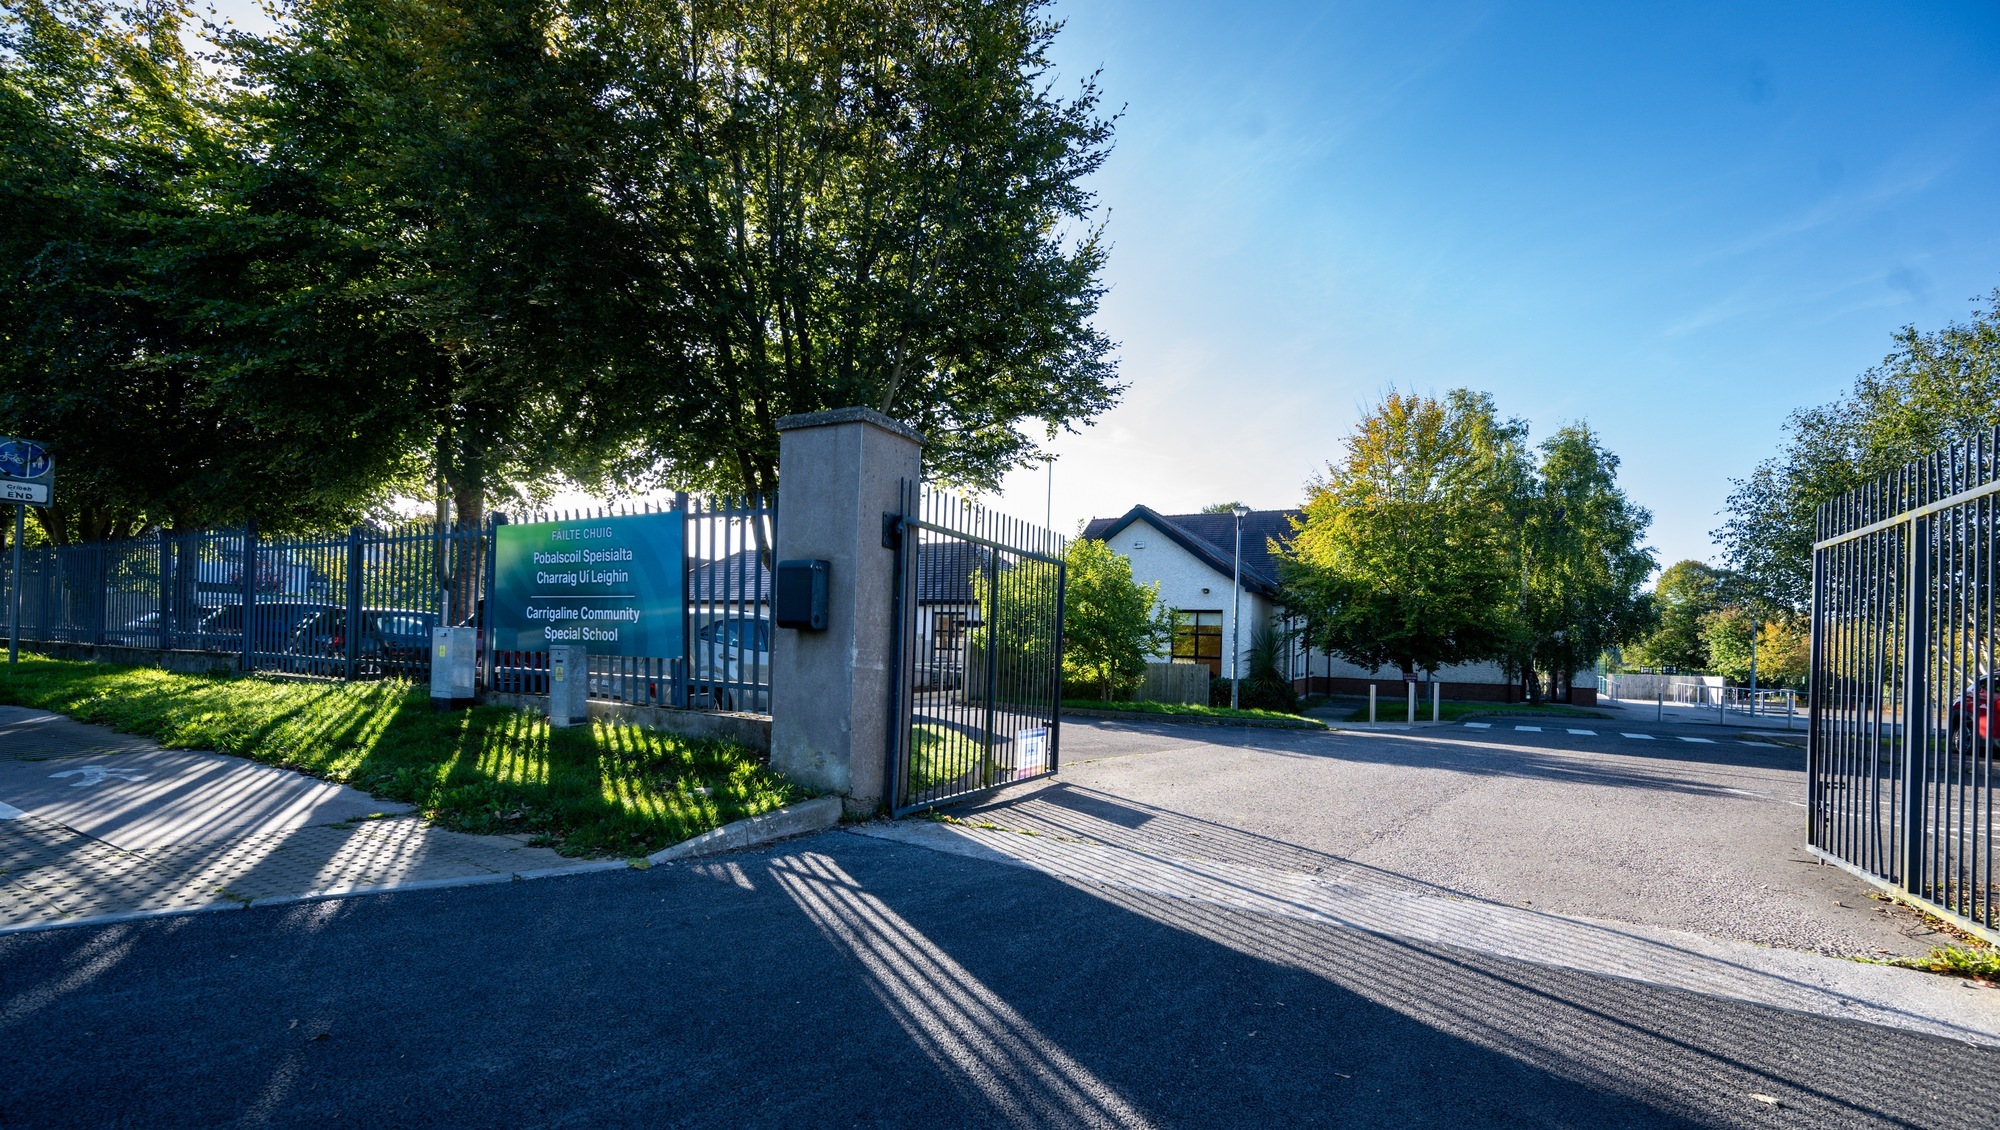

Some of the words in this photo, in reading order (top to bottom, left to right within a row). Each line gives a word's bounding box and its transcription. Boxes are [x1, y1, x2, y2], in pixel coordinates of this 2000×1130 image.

[7, 491, 33, 499] END
[551, 528, 580, 541] FÁILTE
[583, 527, 612, 539] CHUIG
[534, 550, 581, 564] Pobalscoil
[583, 548, 633, 565] Speisialta
[537, 571, 577, 587] Charraig
[579, 569, 589, 584] Uí
[592, 569, 628, 586] Leighin
[526, 606, 578, 622] Carrigaline
[580, 606, 640, 623] Community
[544, 626, 580, 642] Special
[582, 627, 618, 641] School
